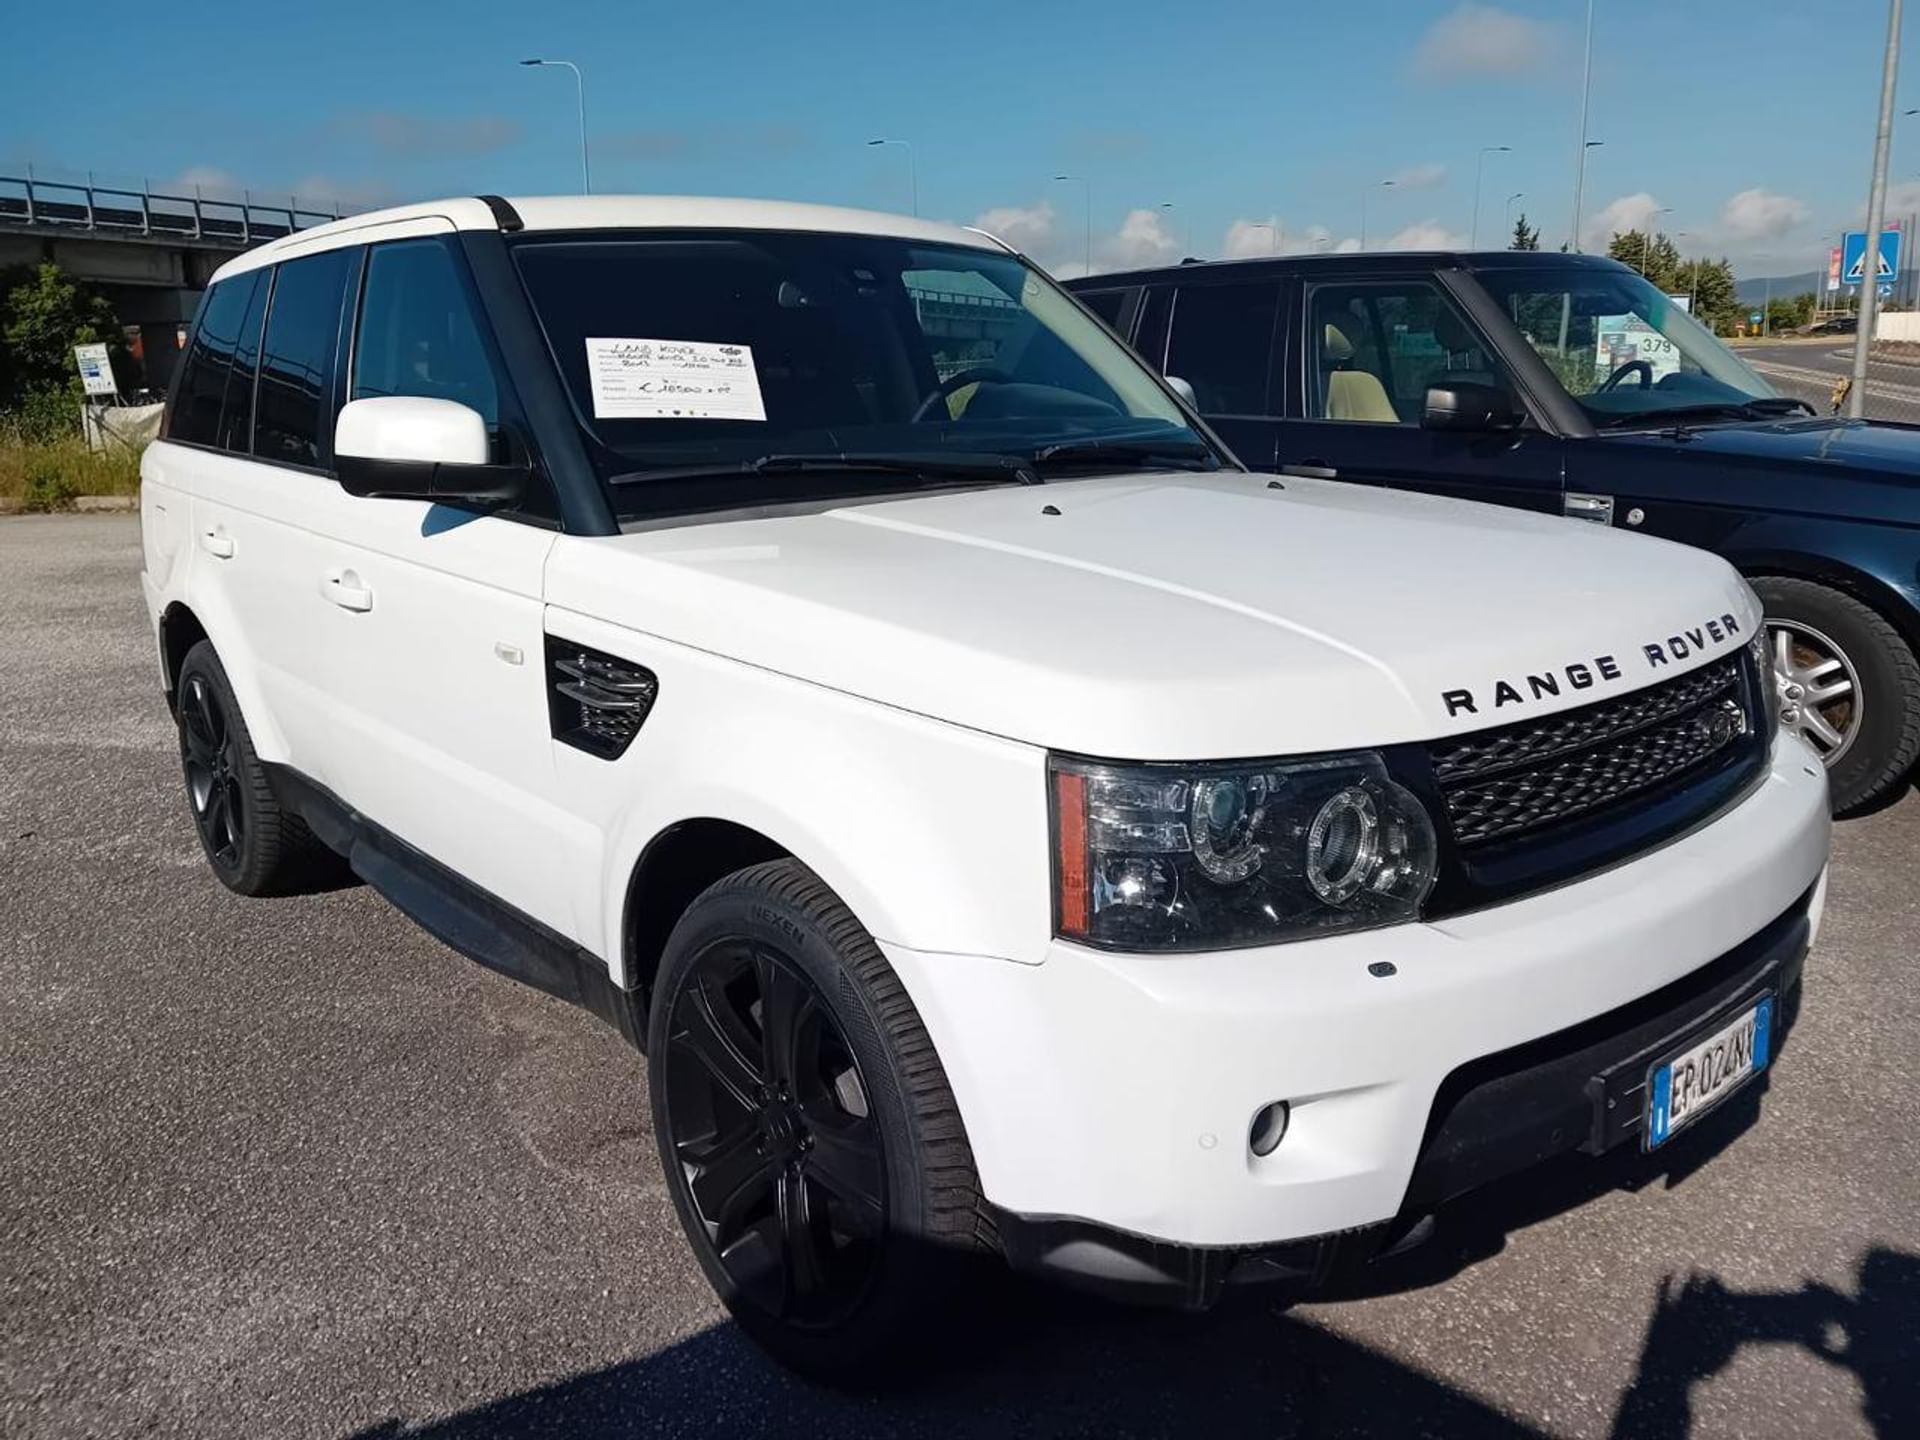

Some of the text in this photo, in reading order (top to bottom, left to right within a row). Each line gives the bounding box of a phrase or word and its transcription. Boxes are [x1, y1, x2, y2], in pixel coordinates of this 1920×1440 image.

[1442, 613, 1740, 717] RANGE ROVER
[752, 903, 805, 945] NEXEN
